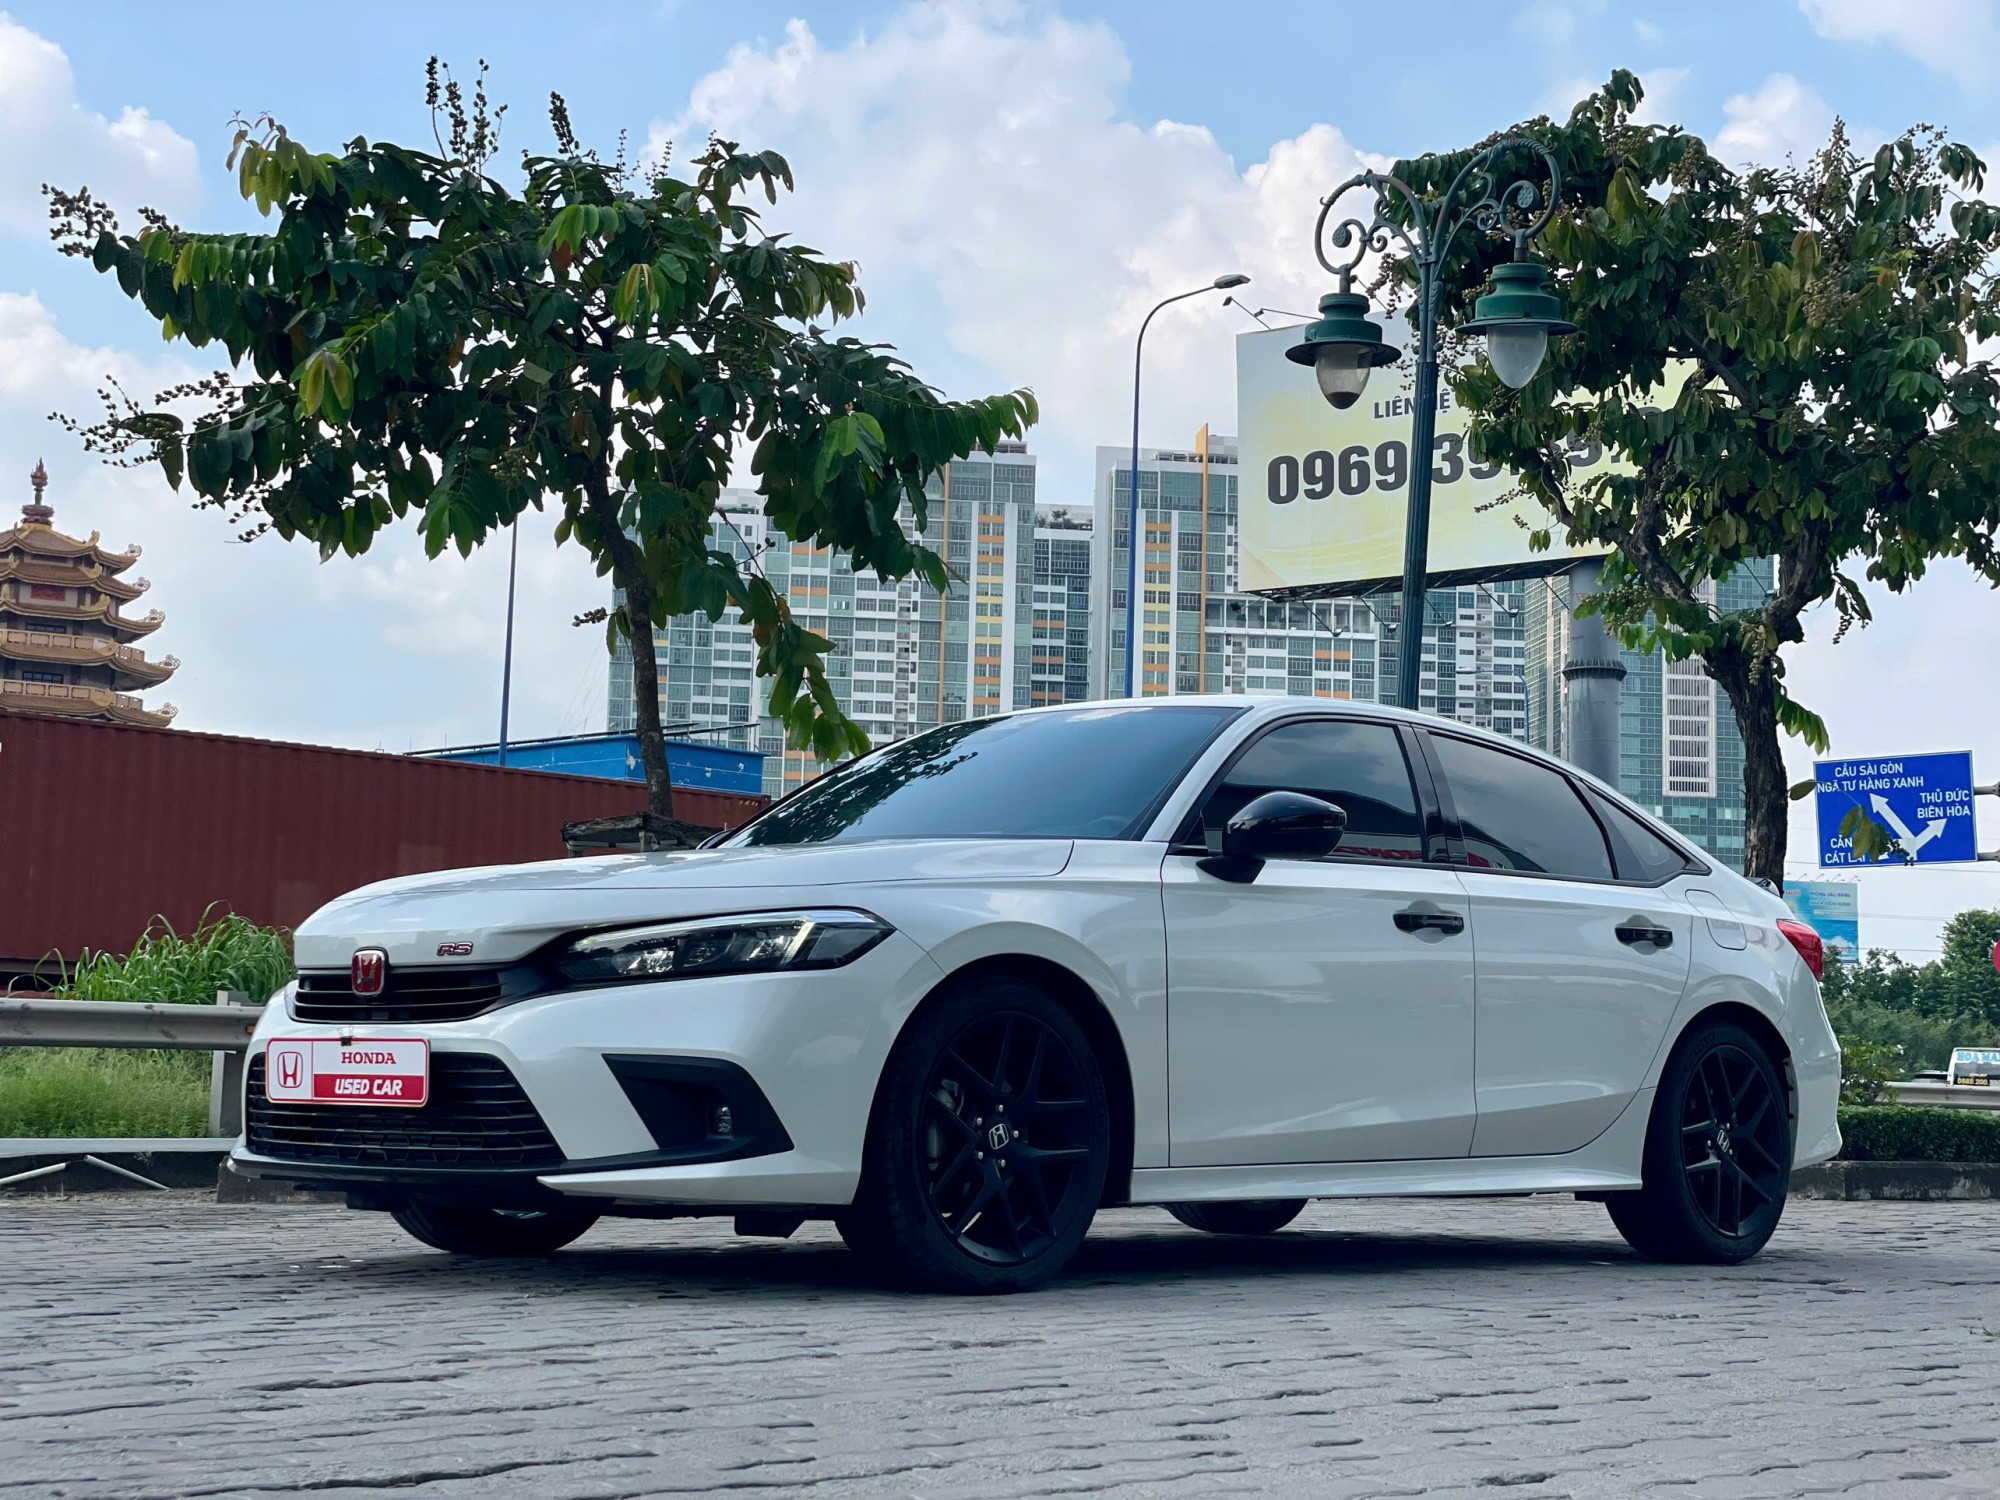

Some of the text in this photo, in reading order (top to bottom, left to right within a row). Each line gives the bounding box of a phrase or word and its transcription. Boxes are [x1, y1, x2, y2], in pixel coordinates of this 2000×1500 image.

[1267, 440, 1408, 504] 0969
[1835, 760, 1903, 777] CẦU SÀI GÒN
[1817, 776, 1924, 793] NGÃ TƯ HÀNG XANH
[1919, 787, 1970, 804] THỦ ĐỨC
[1917, 803, 1971, 819] BIÊN HÒA
[1830, 834, 1853, 849] CẢN
[1824, 850, 1846, 864] CÁT
[437, 942, 473, 956] RS
[341, 1052, 397, 1065] HONDA
[334, 1078, 402, 1096] USED CAR
